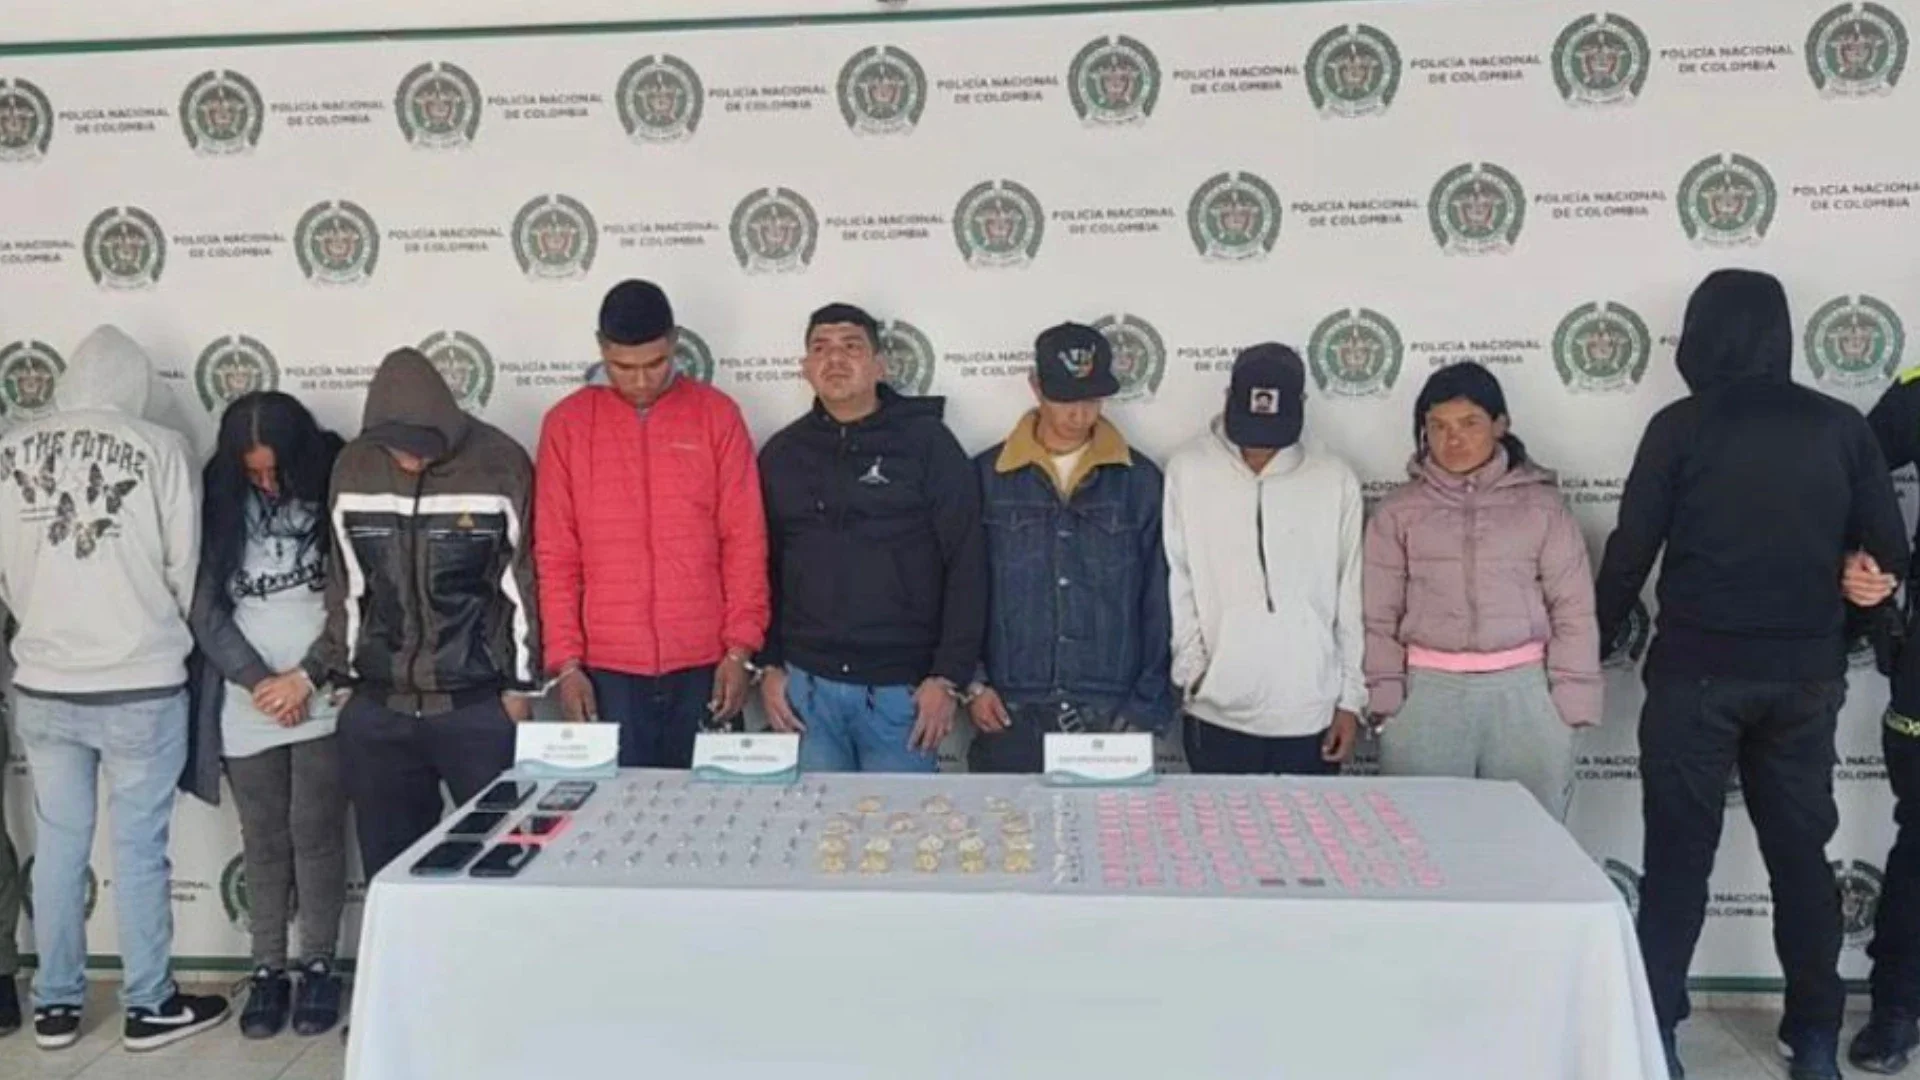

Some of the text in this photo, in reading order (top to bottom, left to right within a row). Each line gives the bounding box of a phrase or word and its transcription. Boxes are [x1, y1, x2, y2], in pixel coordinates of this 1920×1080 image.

[1719, 45, 1795, 58] NACIONAL
[1468, 54, 1543, 67] NACIONAL
[1678, 59, 1778, 74] DE COLOMBIA
[1229, 64, 1301, 78] NACIONAL
[1427, 69, 1525, 84] DE COLOMBIA
[991, 75, 1061, 88] NACIONAL
[1189, 80, 1284, 94] DE COLOMBIA
[761, 84, 831, 97] NACIONAL
[539, 93, 604, 105] NACIONAL
[954, 90, 1044, 104] DE COLOMBIA
[321, 100, 387, 112] NACIONAL
[724, 100, 813, 112] DE COLOMBIA
[108, 107, 171, 119] NACIONAL
[502, 107, 590, 119] DE COLOMBIA
[286, 114, 373, 126] DE COLOMBIA
[74, 122, 157, 133] DE COLOMBIA
[1852, 182, 1920, 195] NACIONA
[1593, 190, 1668, 203] NACIONAL
[1348, 198, 1421, 211] NACIONAL
[1811, 197, 1912, 211] DE COLOMBIA
[1106, 206, 1177, 219] NACIONAL
[1551, 205, 1650, 218] DE COLOMBIA
[878, 213, 947, 226] NACIONAL
[1308, 214, 1404, 226] DE COLOMBIA
[439, 227, 505, 239] NACIONAL
[654, 222, 721, 233] NACIONAL
[1069, 222, 1161, 234] DE COLOMBIA
[223, 233, 288, 244] NACIONAL
[842, 228, 931, 240] DE COLOMBIA
[14, 239, 77, 251] NACIONAL
[404, 241, 490, 253] DE COLOMBIA
[619, 236, 706, 247] DE COLOMBIA
[188, 247, 274, 258] DE COLOMBIA
[1469, 338, 1541, 350] NACIONAL
[1195, 361, 1212, 371] DE
[1429, 355, 1447, 367] DE
[736, 371, 751, 382] DE
[960, 366, 978, 377] DE
[301, 380, 317, 390] DE
[516, 376, 531, 387] DE
[23, 430, 66, 464] THE
[71, 429, 148, 481] FUTURE
[1593, 755, 1637, 766] NACIO
[1714, 893, 1769, 902] NACION
[1706, 906, 1769, 917] OLOMBIA
